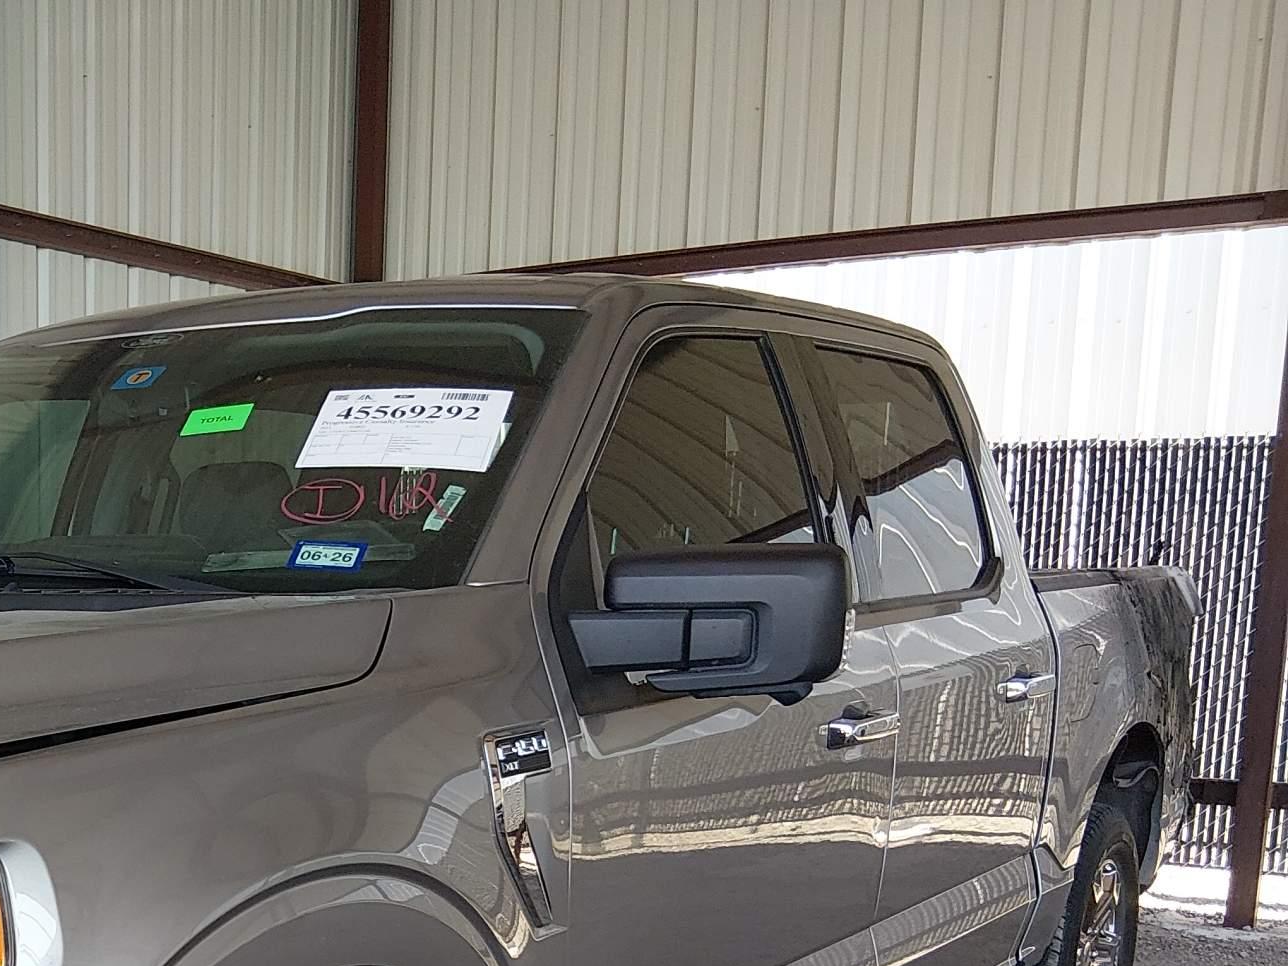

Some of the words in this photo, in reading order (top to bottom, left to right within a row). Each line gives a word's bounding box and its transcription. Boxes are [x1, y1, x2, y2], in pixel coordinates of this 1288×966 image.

[336, 404, 481, 421] 45569292
[200, 415, 234, 425] TOTAL
[300, 550, 323, 561] 06
[329, 552, 354, 563] 26
